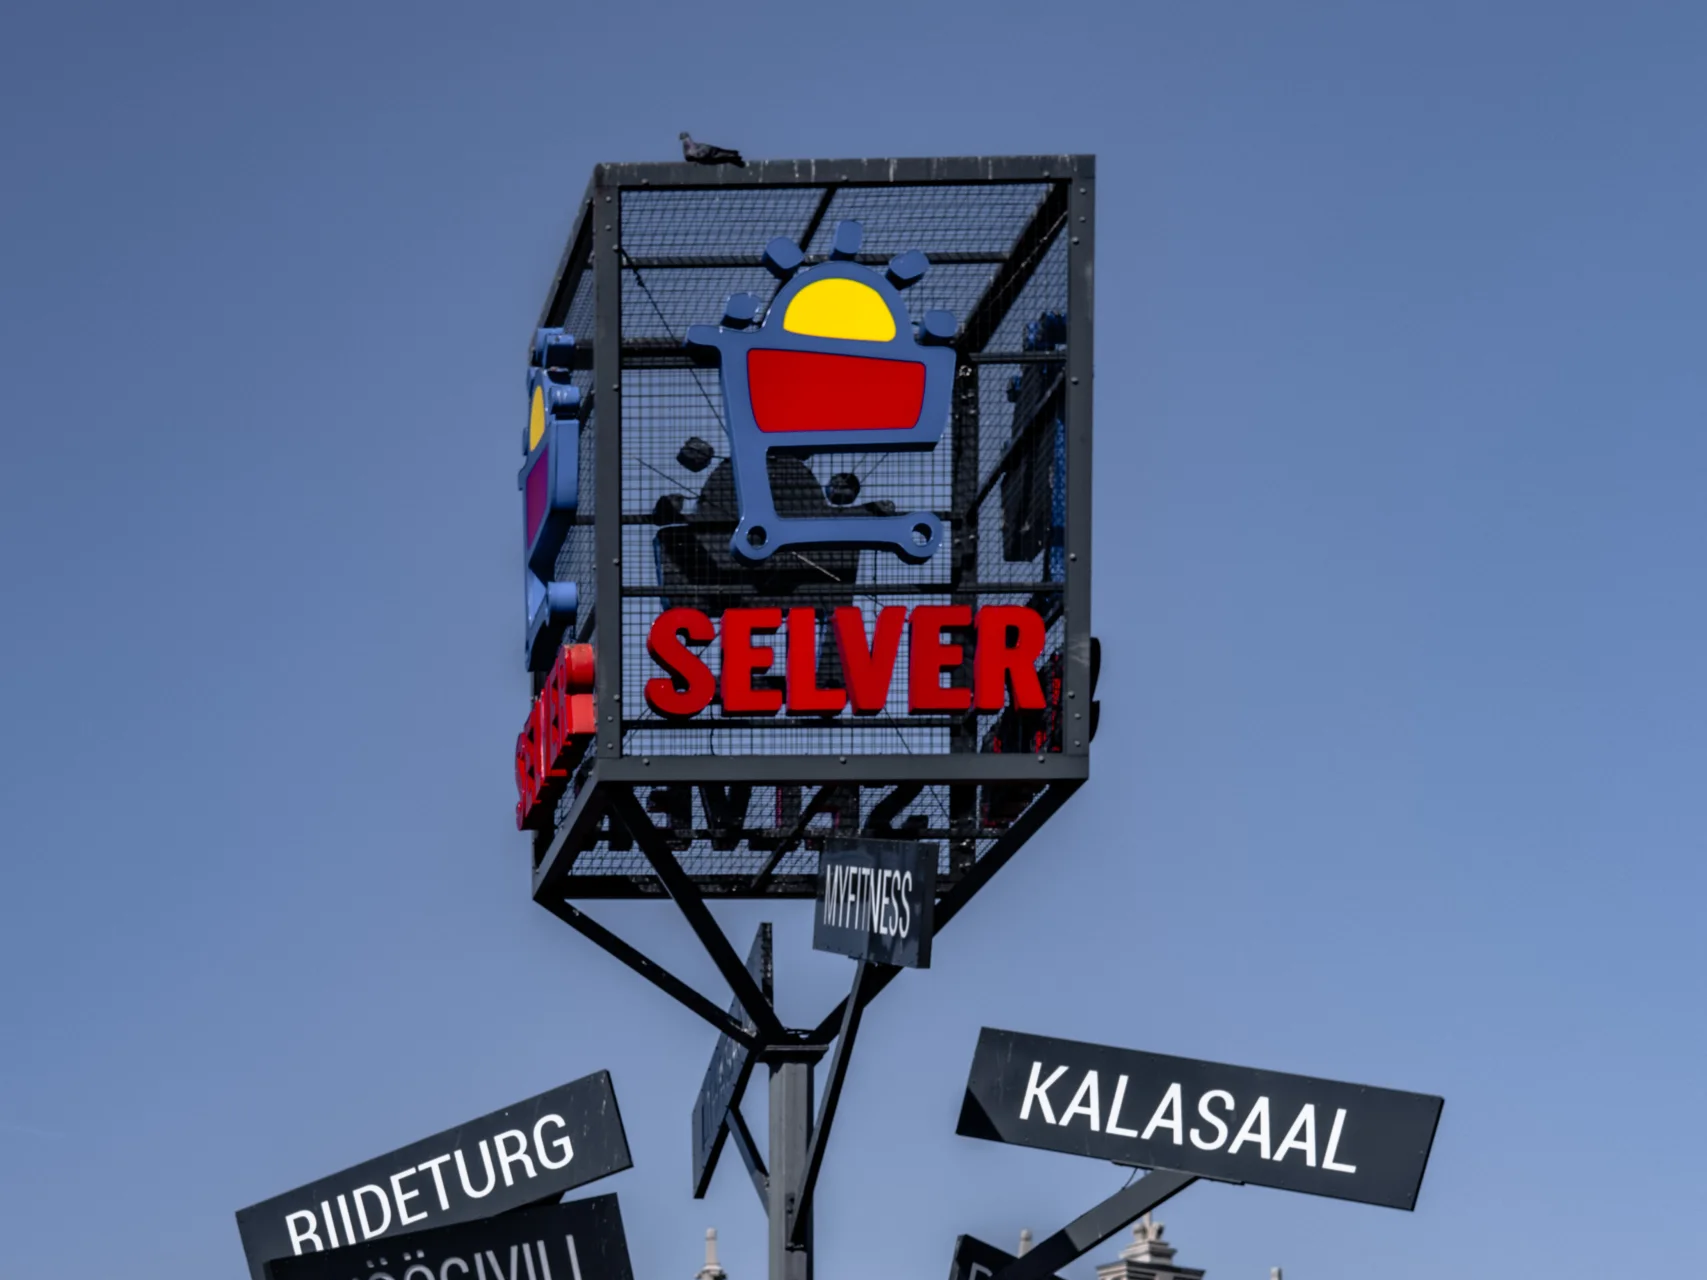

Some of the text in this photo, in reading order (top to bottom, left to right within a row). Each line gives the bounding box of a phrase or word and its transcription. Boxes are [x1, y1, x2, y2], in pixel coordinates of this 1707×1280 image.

[644, 604, 1047, 716] SELVER
[823, 864, 914, 939] MYFITNESS
[1019, 1061, 1358, 1174] KALASAAL
[285, 1113, 575, 1256] RIIDETURG
